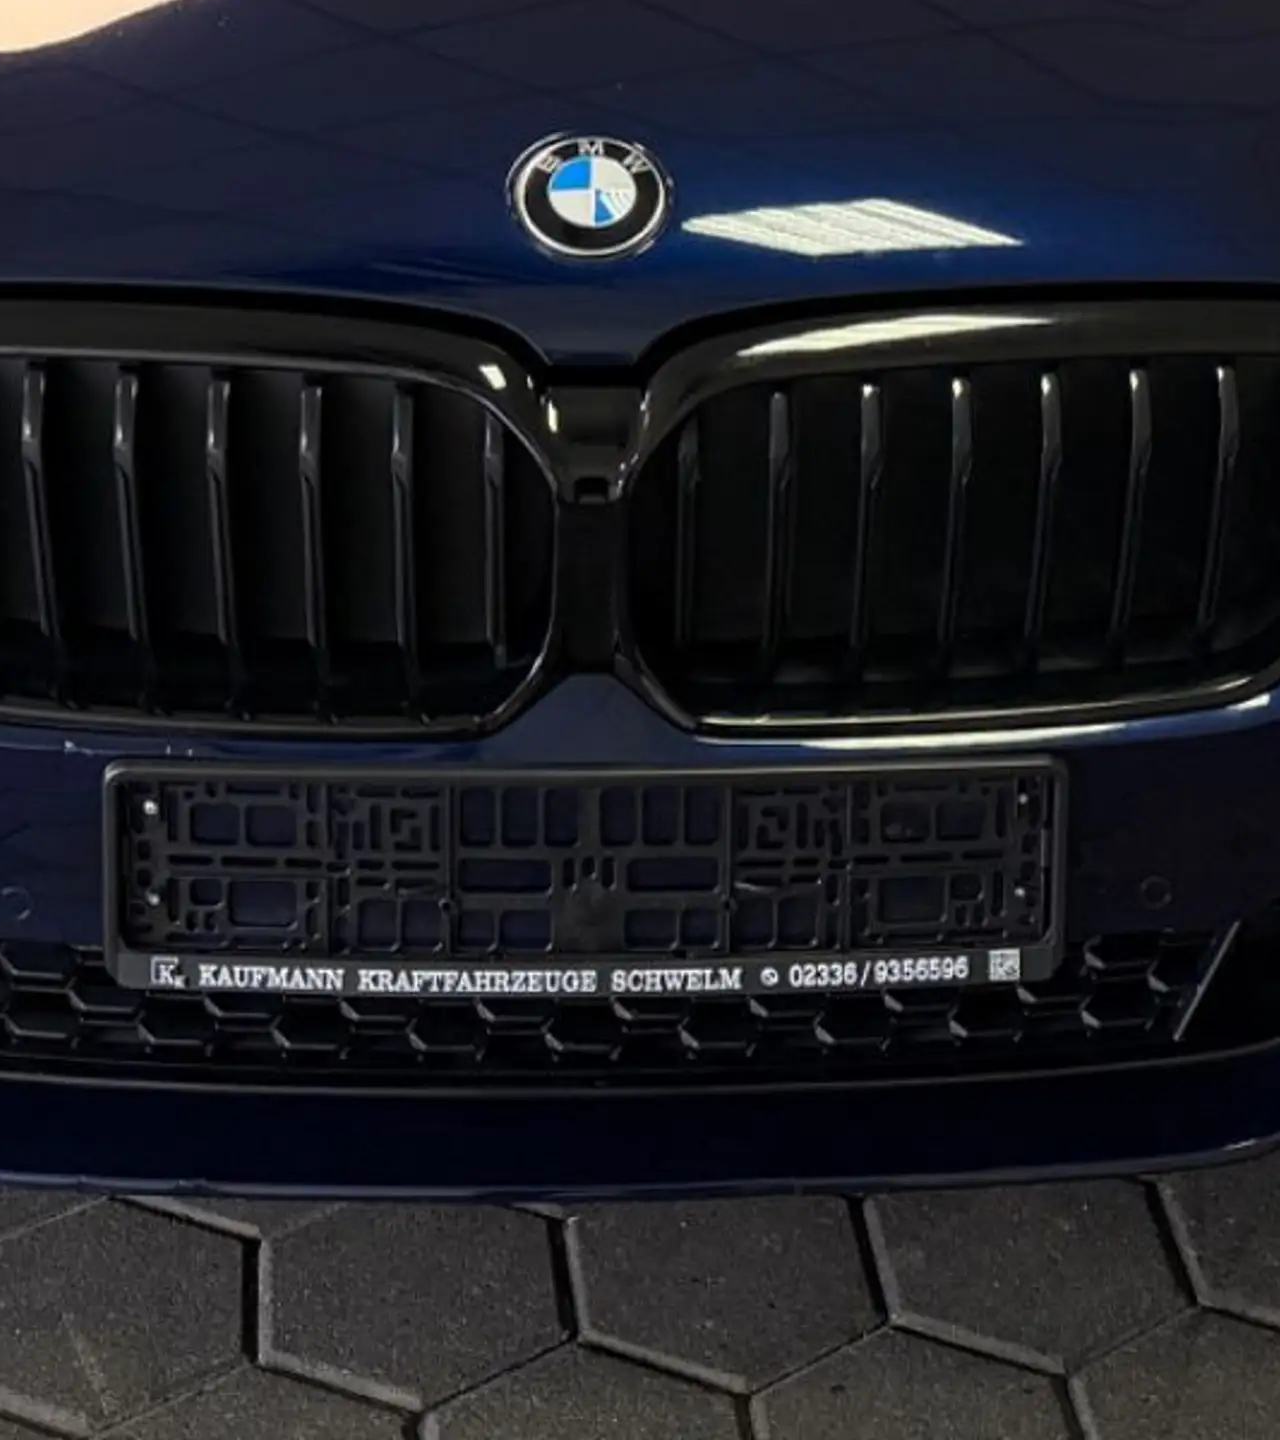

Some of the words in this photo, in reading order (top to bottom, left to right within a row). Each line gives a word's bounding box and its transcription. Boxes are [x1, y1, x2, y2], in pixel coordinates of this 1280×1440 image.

[538, 139, 650, 173] BMW
[199, 964, 345, 991] KAUFMANN
[357, 969, 597, 993] KRAFTFAHRZEUGE
[611, 968, 743, 993] SCHWELM
[788, 956, 969, 988] 02336/9356596
